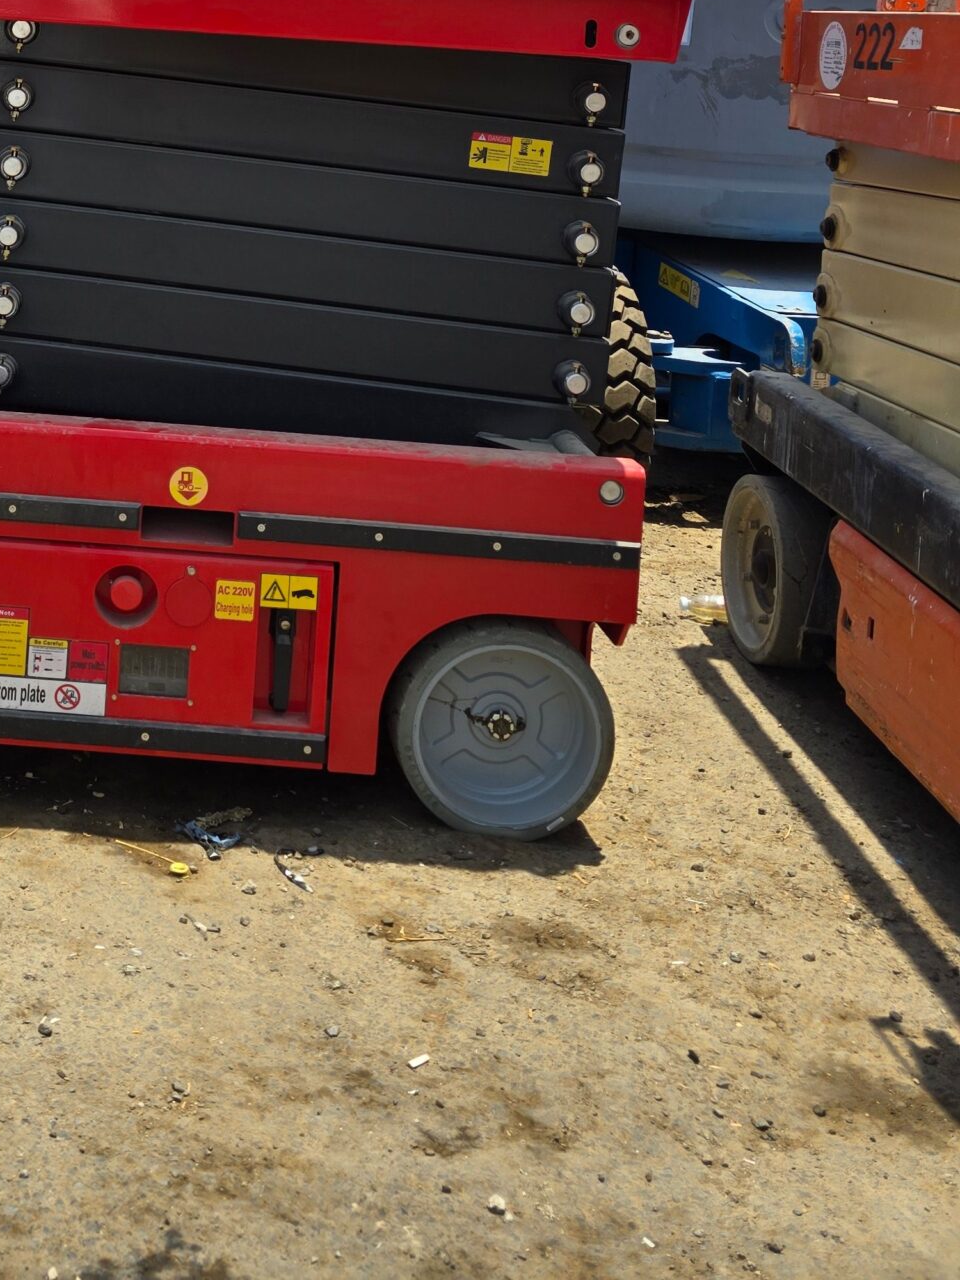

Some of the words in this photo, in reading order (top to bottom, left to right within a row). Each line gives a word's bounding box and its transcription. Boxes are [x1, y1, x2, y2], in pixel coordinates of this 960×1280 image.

[854, 22, 895, 70] 222
[218, 586, 230, 595] AC
[232, 586, 254, 597] 220V
[0, 609, 15, 617] Note
[215, 601, 240, 616] Charging
[20, 683, 46, 706] plate
